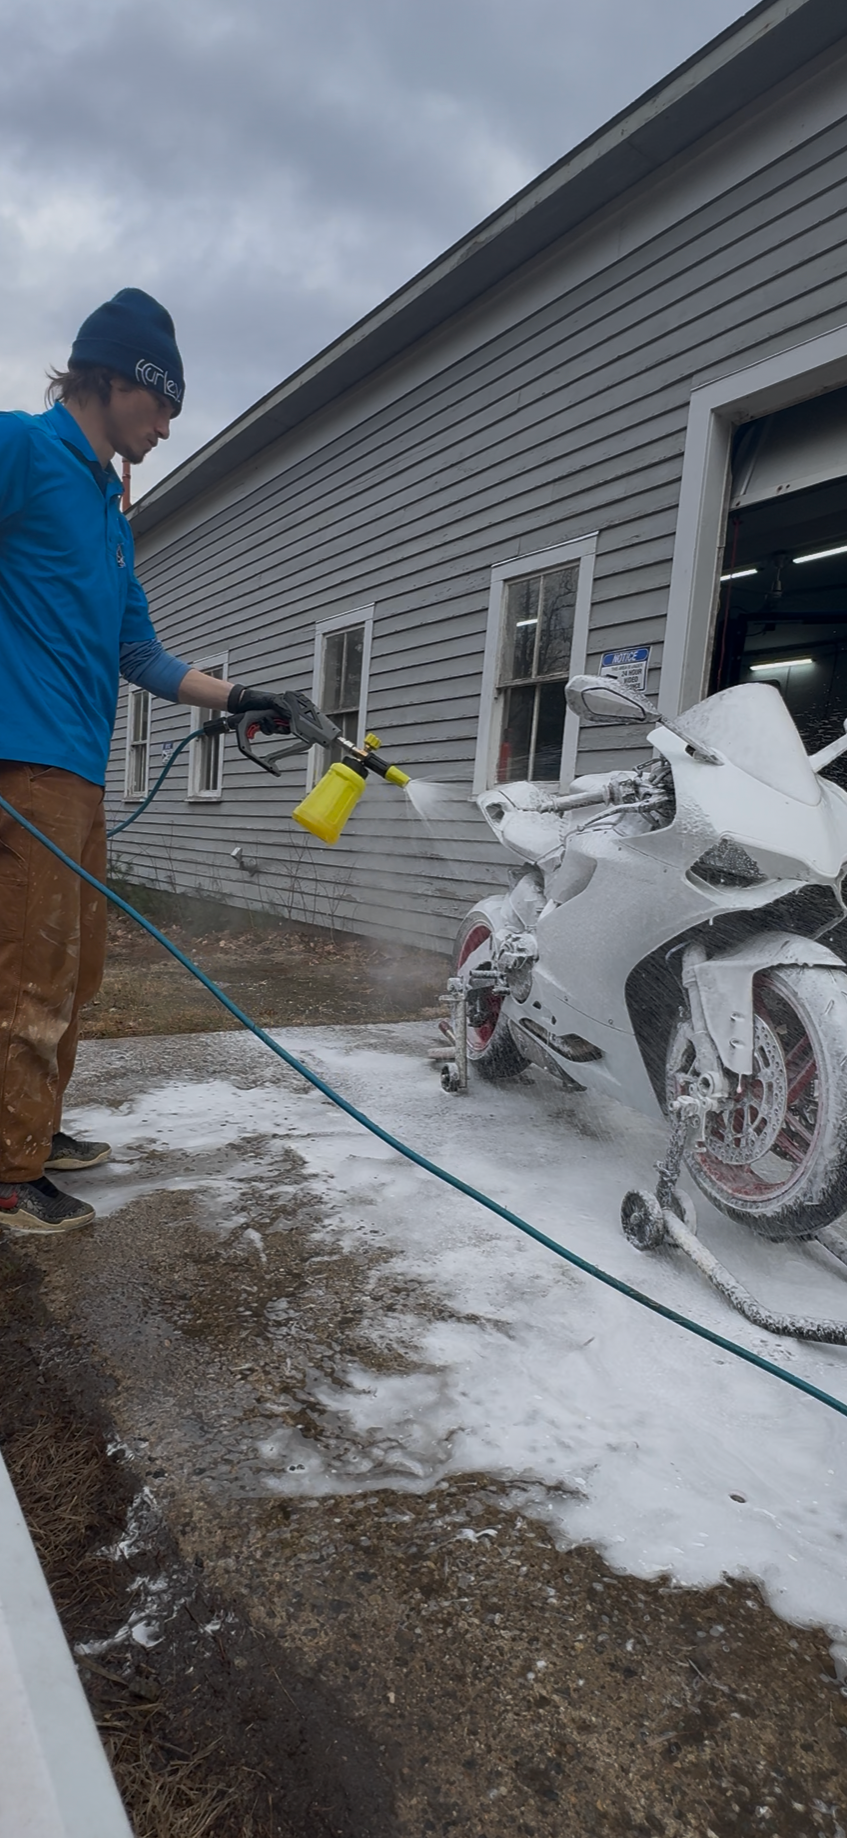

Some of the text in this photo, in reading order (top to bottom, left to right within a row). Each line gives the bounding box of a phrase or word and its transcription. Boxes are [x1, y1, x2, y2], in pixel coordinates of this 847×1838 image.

[135, 358, 183, 403] Hurley
[612, 651, 639, 663] NOTICE
[623, 676, 639, 684] VIDEO
